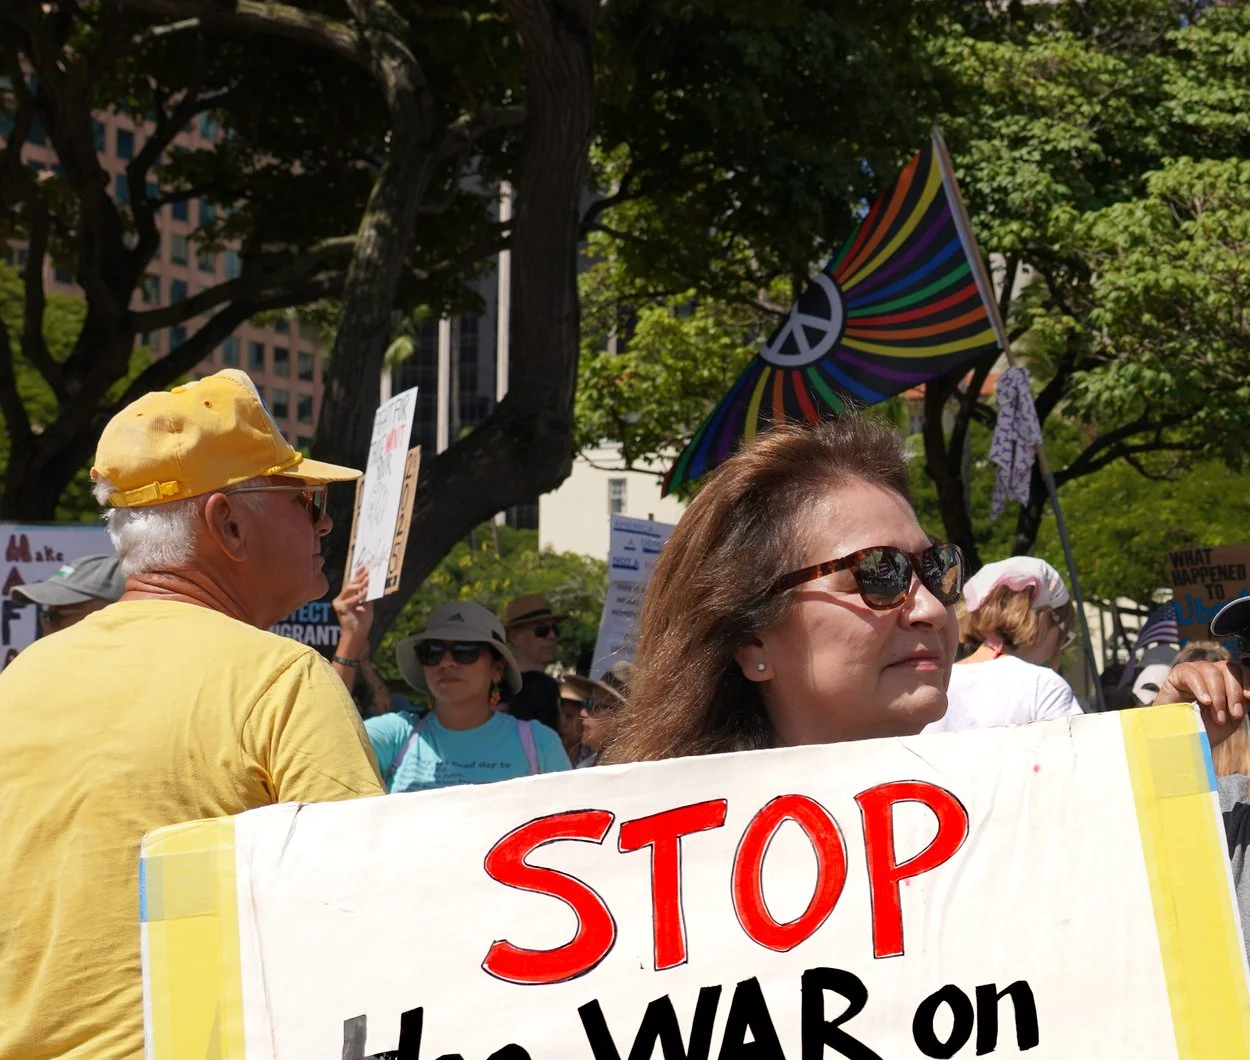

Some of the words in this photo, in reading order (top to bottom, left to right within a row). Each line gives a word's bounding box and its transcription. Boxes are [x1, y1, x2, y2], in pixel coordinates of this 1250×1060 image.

[5, 534, 64, 562] Make
[1169, 548, 1212, 568] WHAT
[1171, 564, 1247, 586] HAPPENED
[1205, 583, 1225, 600] TO
[480, 780, 970, 985] STOP
[912, 979, 1039, 1060] on
